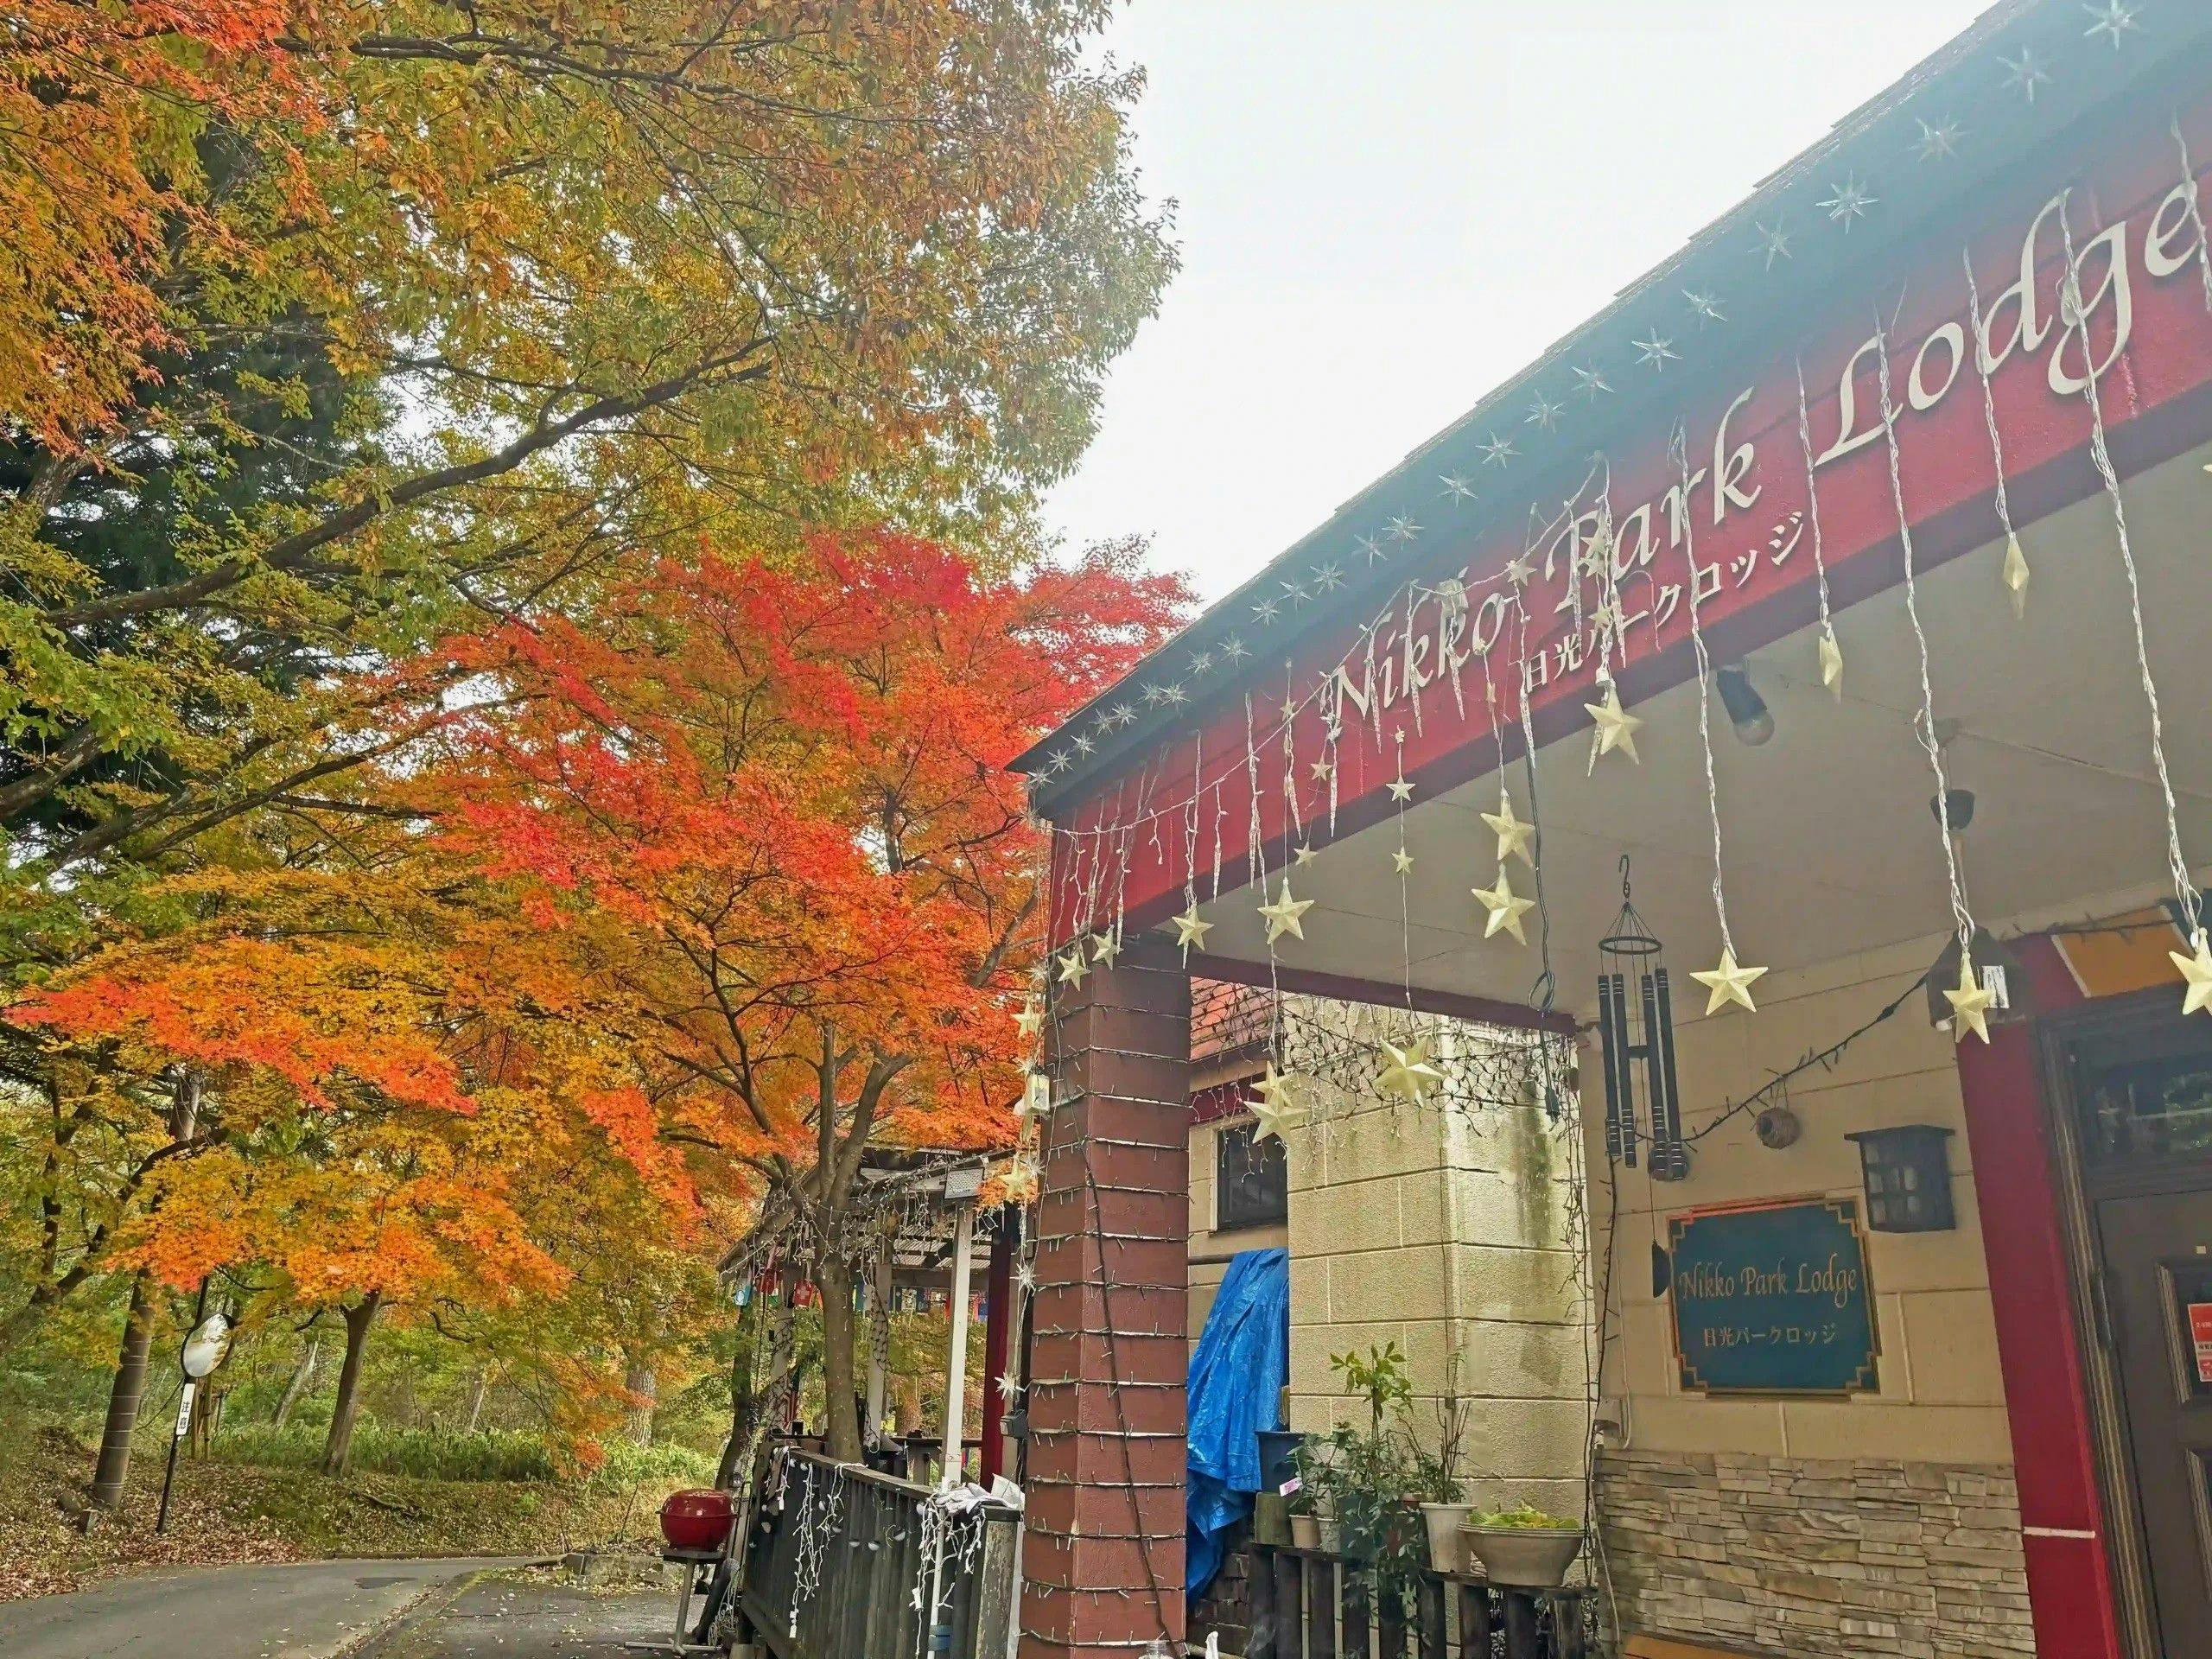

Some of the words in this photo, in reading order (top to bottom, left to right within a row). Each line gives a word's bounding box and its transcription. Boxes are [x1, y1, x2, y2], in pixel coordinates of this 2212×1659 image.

[1320, 567, 1504, 728] Nikko
[1545, 386, 1761, 613] Park
[1813, 180, 2203, 468] Lodge
[1679, 1261, 1735, 1300] Nikko
[1740, 1256, 1789, 1296] Park
[1795, 1253, 1857, 1308] Lodge
[1704, 1322, 1838, 1347] 日光パークロッジ
